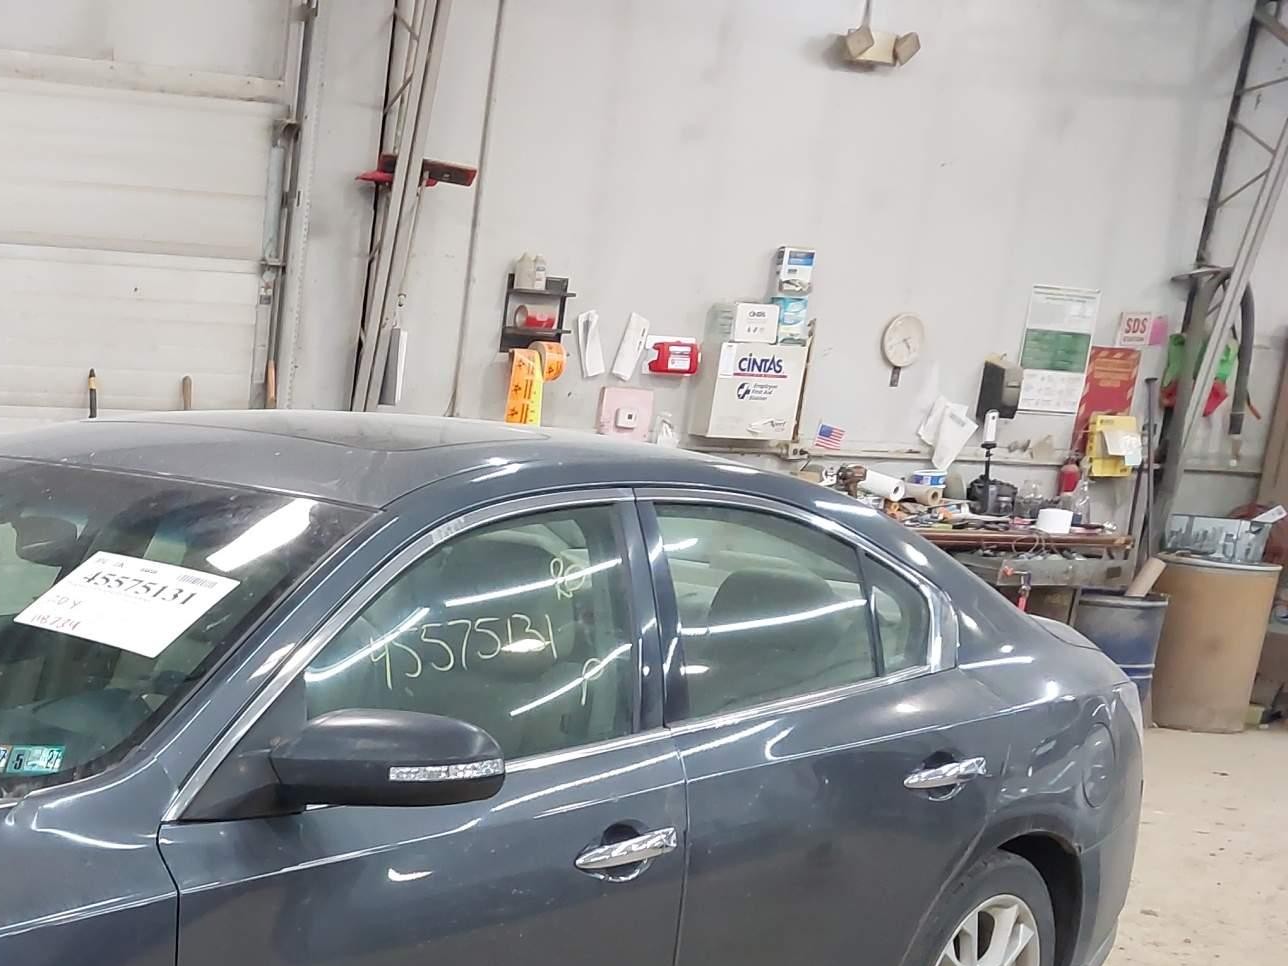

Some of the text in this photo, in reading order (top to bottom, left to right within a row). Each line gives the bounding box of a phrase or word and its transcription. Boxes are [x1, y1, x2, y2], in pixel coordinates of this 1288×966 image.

[1124, 317, 1148, 334] SDS
[83, 571, 198, 605] 45575131
[369, 613, 558, 690] 45575131
[14, 753, 24, 770] 5
